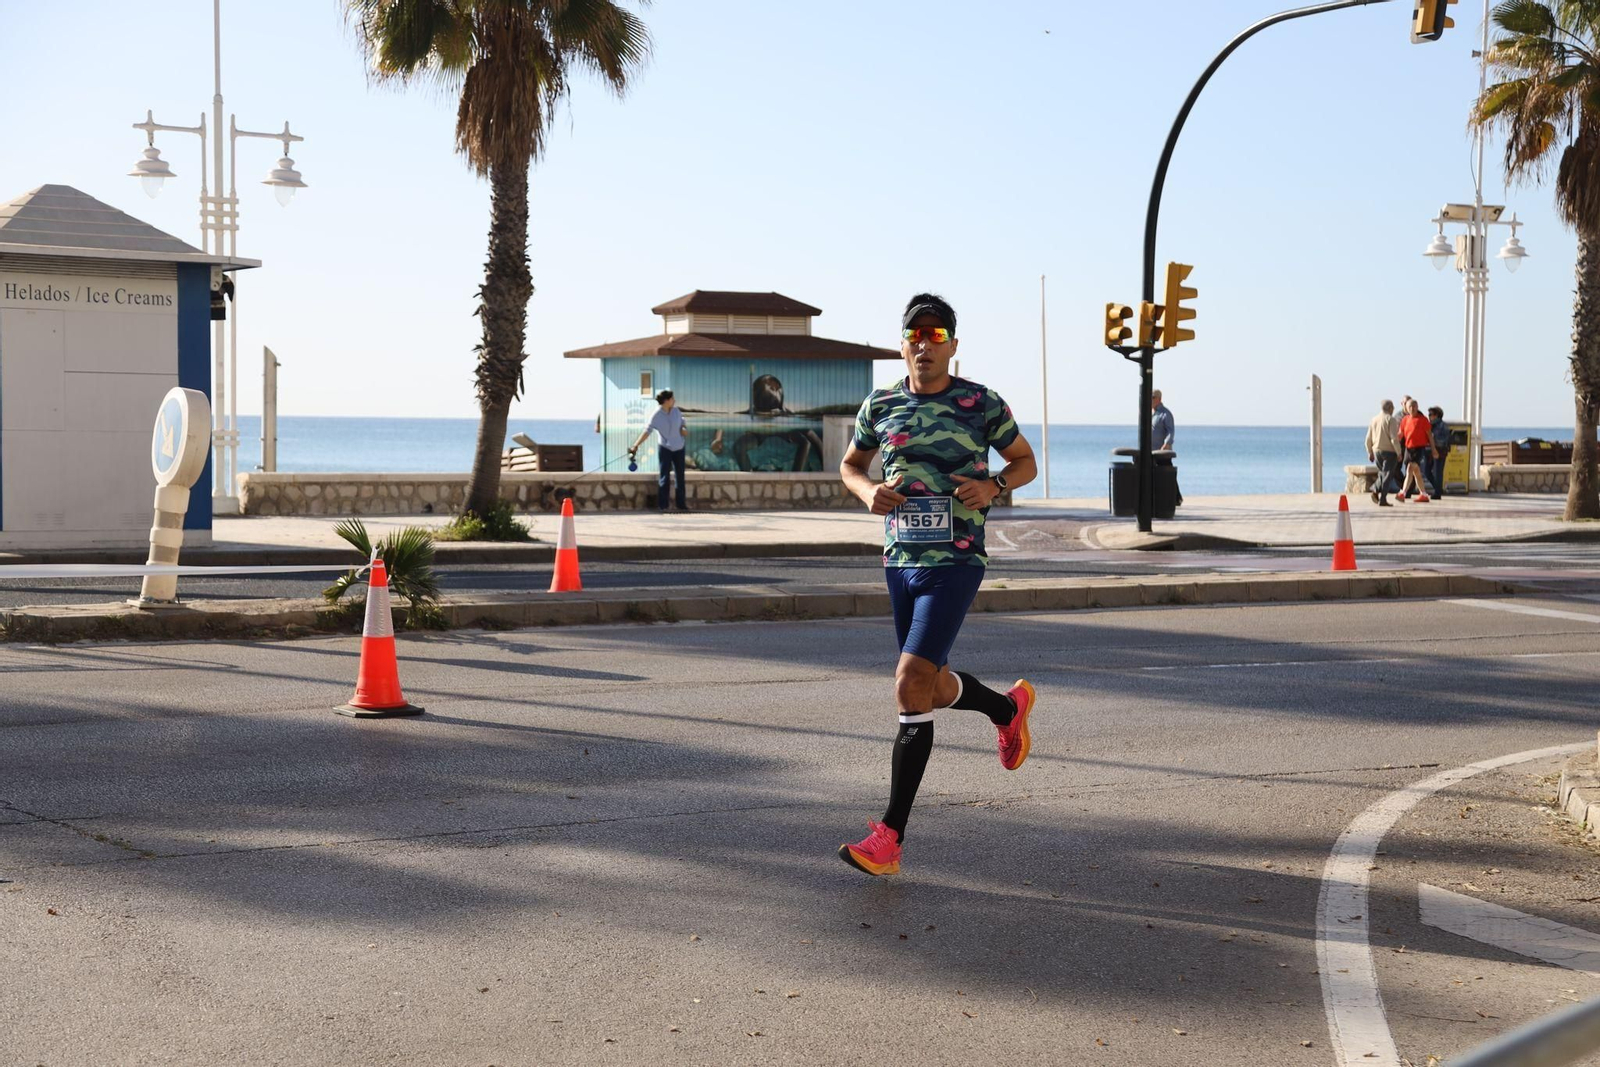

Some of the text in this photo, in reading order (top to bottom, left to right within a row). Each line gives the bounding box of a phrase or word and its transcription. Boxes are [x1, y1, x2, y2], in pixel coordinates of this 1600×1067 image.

[5, 283, 173, 306] Helados / Ice Creams
[901, 514, 944, 527] 1567
